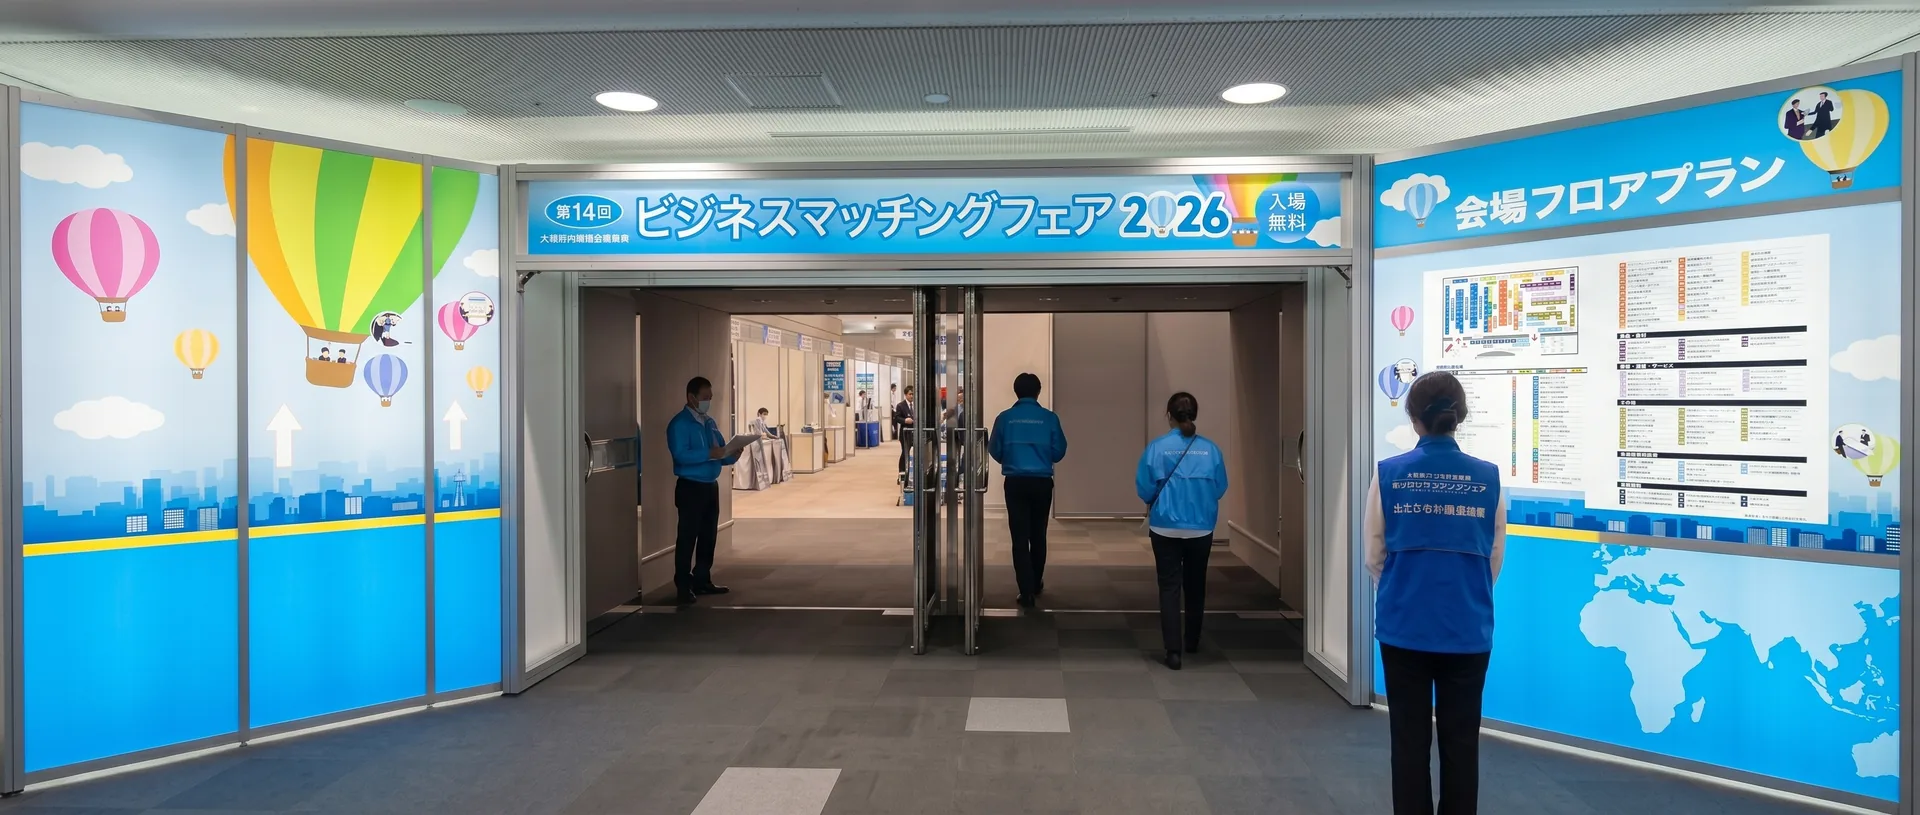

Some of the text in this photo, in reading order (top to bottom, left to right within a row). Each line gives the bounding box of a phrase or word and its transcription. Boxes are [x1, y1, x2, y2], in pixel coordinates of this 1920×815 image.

[1268, 192, 1307, 211] 入場
[1454, 156, 1786, 231] 会場フロアプラン
[555, 202, 612, 221] 第14回
[636, 191, 1115, 240] ビジネスマッチングフェア
[1268, 213, 1307, 232] 無料
